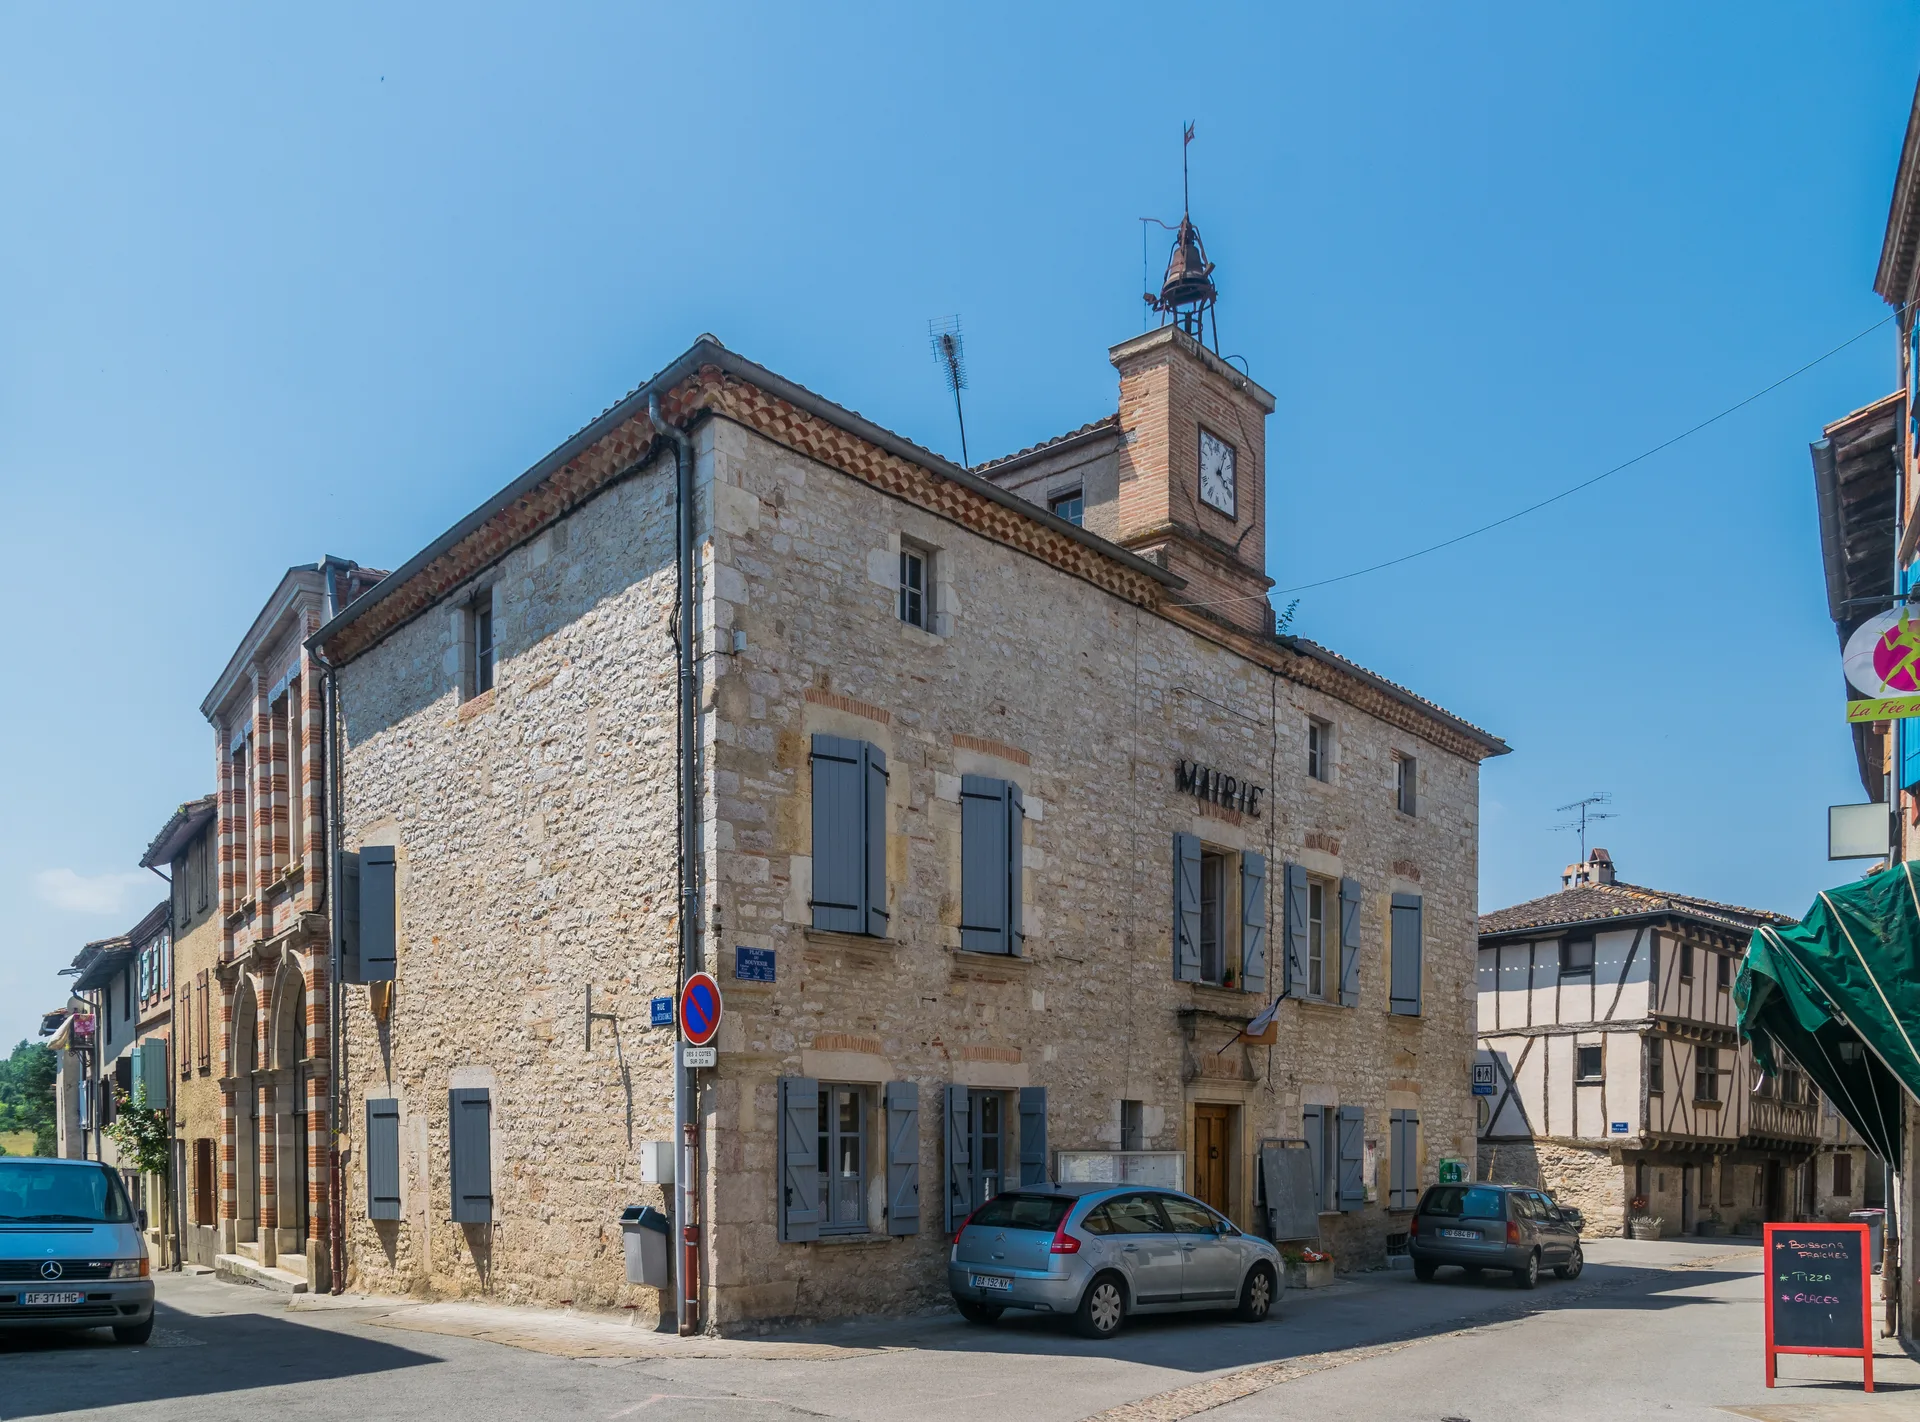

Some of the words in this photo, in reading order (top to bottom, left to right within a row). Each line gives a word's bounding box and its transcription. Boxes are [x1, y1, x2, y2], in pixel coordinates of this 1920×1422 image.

[1849, 703, 1870, 717] La
[1878, 700, 1904, 714] Fée
[1175, 758, 1265, 818] MAIRIE
[744, 959, 768, 967] SOUVENIR
[657, 1002, 665, 1011] RUE
[1791, 1271, 1832, 1282] PIZZA
[27, 1293, 77, 1303] AF-371-HG
[1794, 1292, 1840, 1304] GLACES
